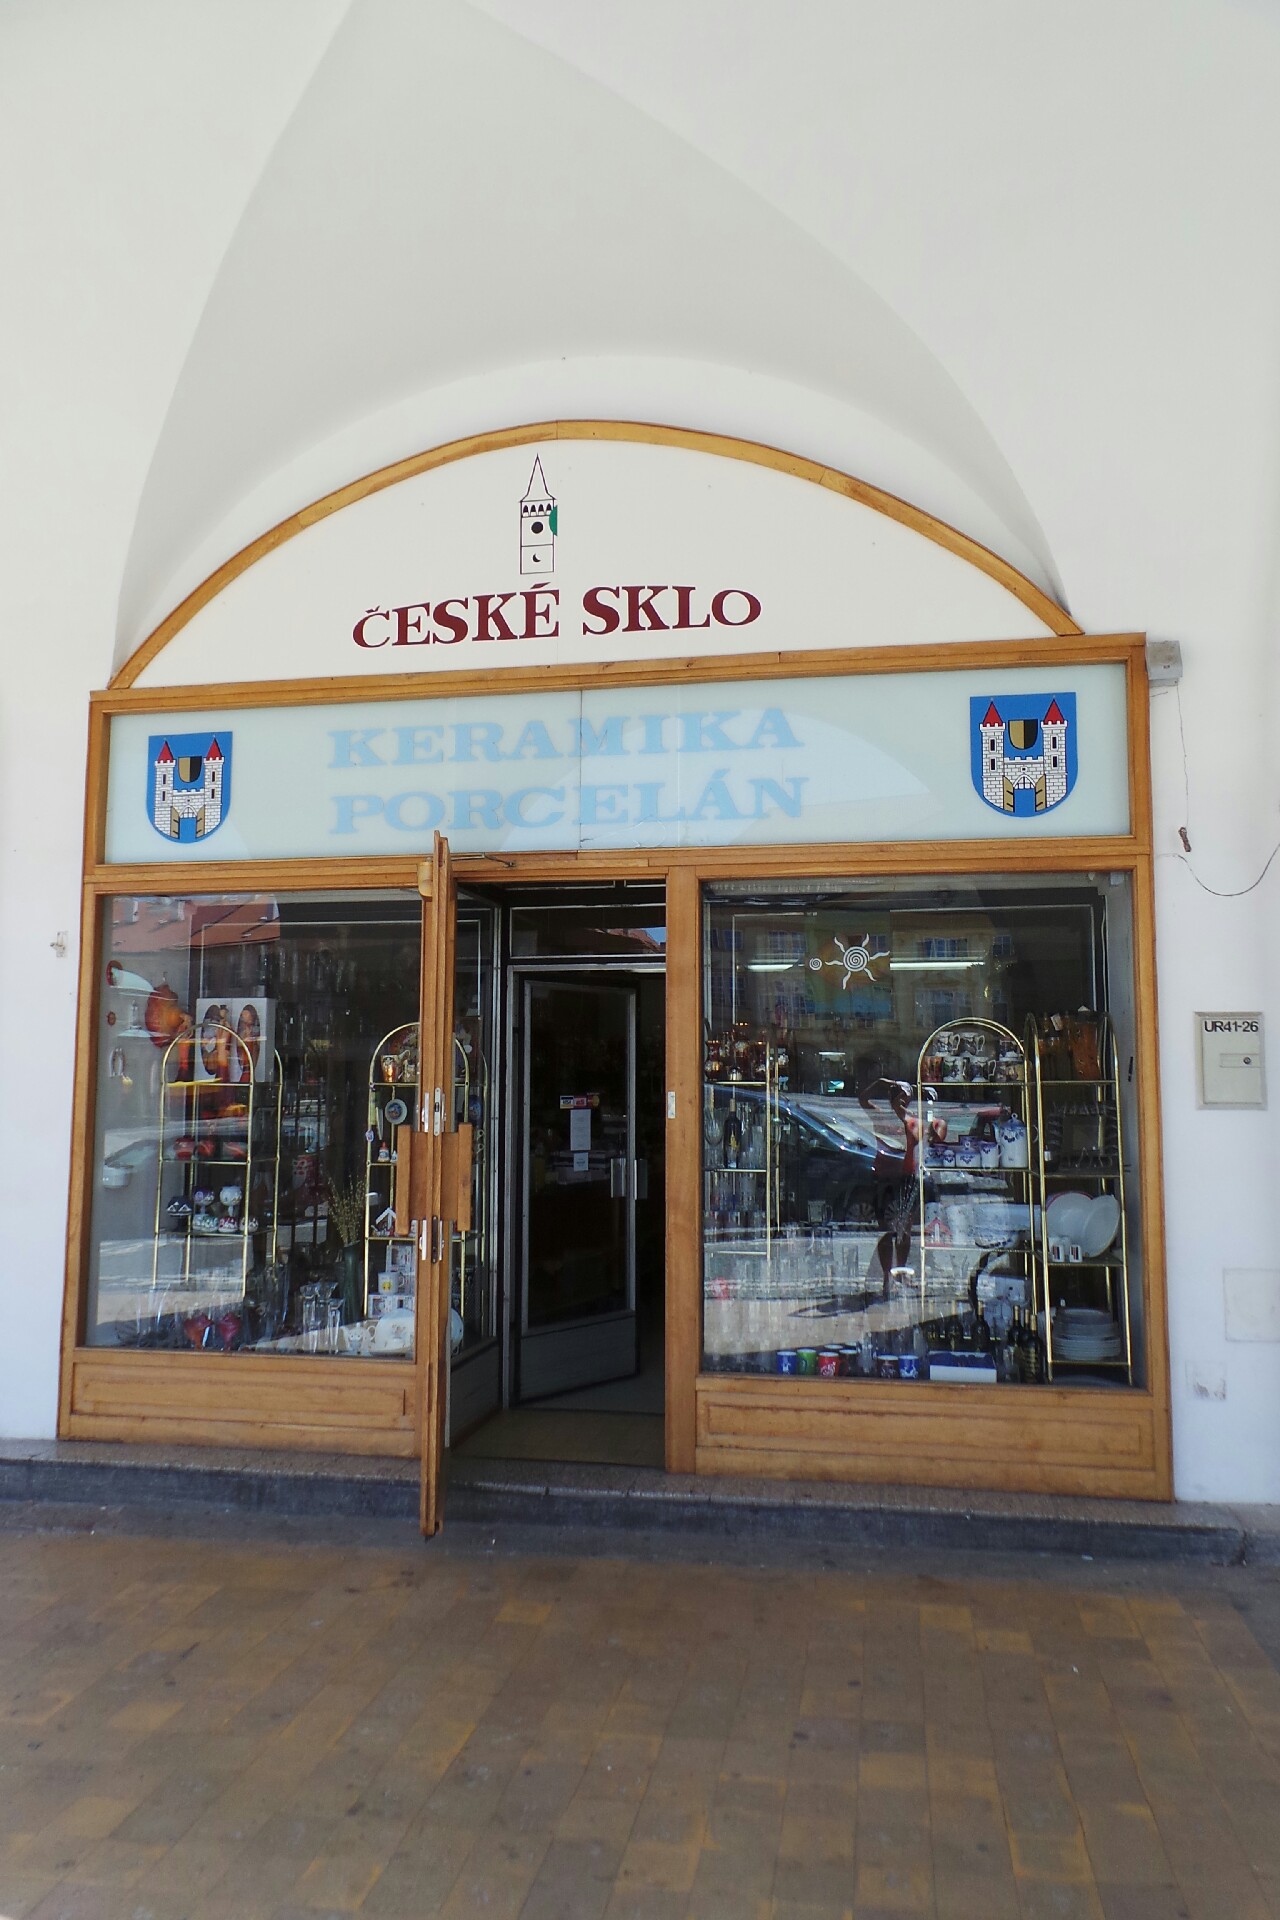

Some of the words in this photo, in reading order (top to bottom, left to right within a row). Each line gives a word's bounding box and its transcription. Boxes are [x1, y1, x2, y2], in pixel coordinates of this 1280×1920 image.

[352, 582, 559, 649] ČESKÉ
[582, 585, 763, 636] SKLO
[326, 706, 805, 769] KERAMIKA
[329, 768, 810, 834] PORCELÁN
[1203, 1020, 1259, 1033] UR41-26
